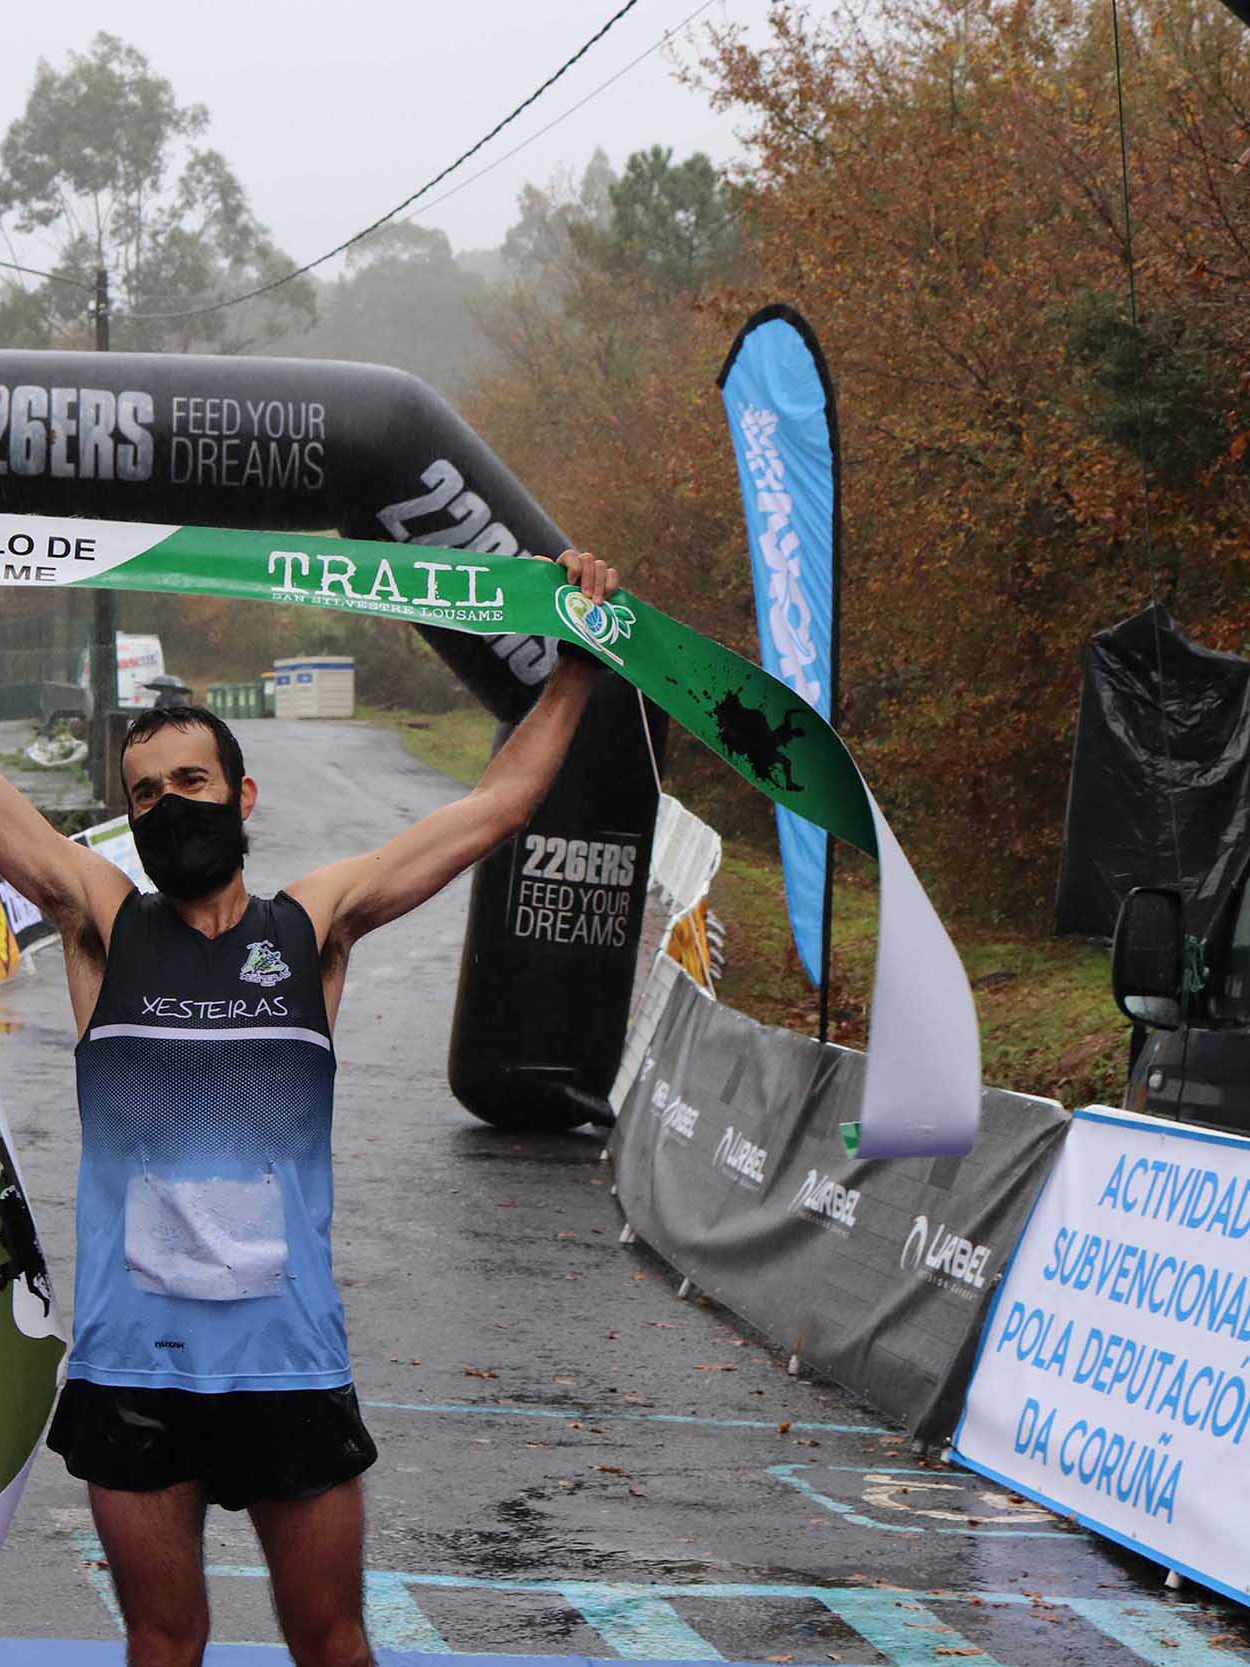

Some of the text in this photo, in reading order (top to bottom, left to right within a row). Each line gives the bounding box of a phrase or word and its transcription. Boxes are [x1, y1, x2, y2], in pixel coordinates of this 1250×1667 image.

[171, 396, 326, 441] FEED YOUR
[169, 436, 326, 490] DREAMS
[46, 535, 97, 562] DE
[267, 550, 505, 607] TRAIL
[421, 606, 505, 621] LOUSAME
[521, 834, 638, 887] 226ERS
[518, 880, 631, 916] FEED YOUR
[514, 905, 628, 947] DREAMS
[141, 996, 289, 1019] XESTEIRAS
[997, 1301, 1075, 1377] POLA
[1013, 1396, 1184, 1525] DA CORUÑA
